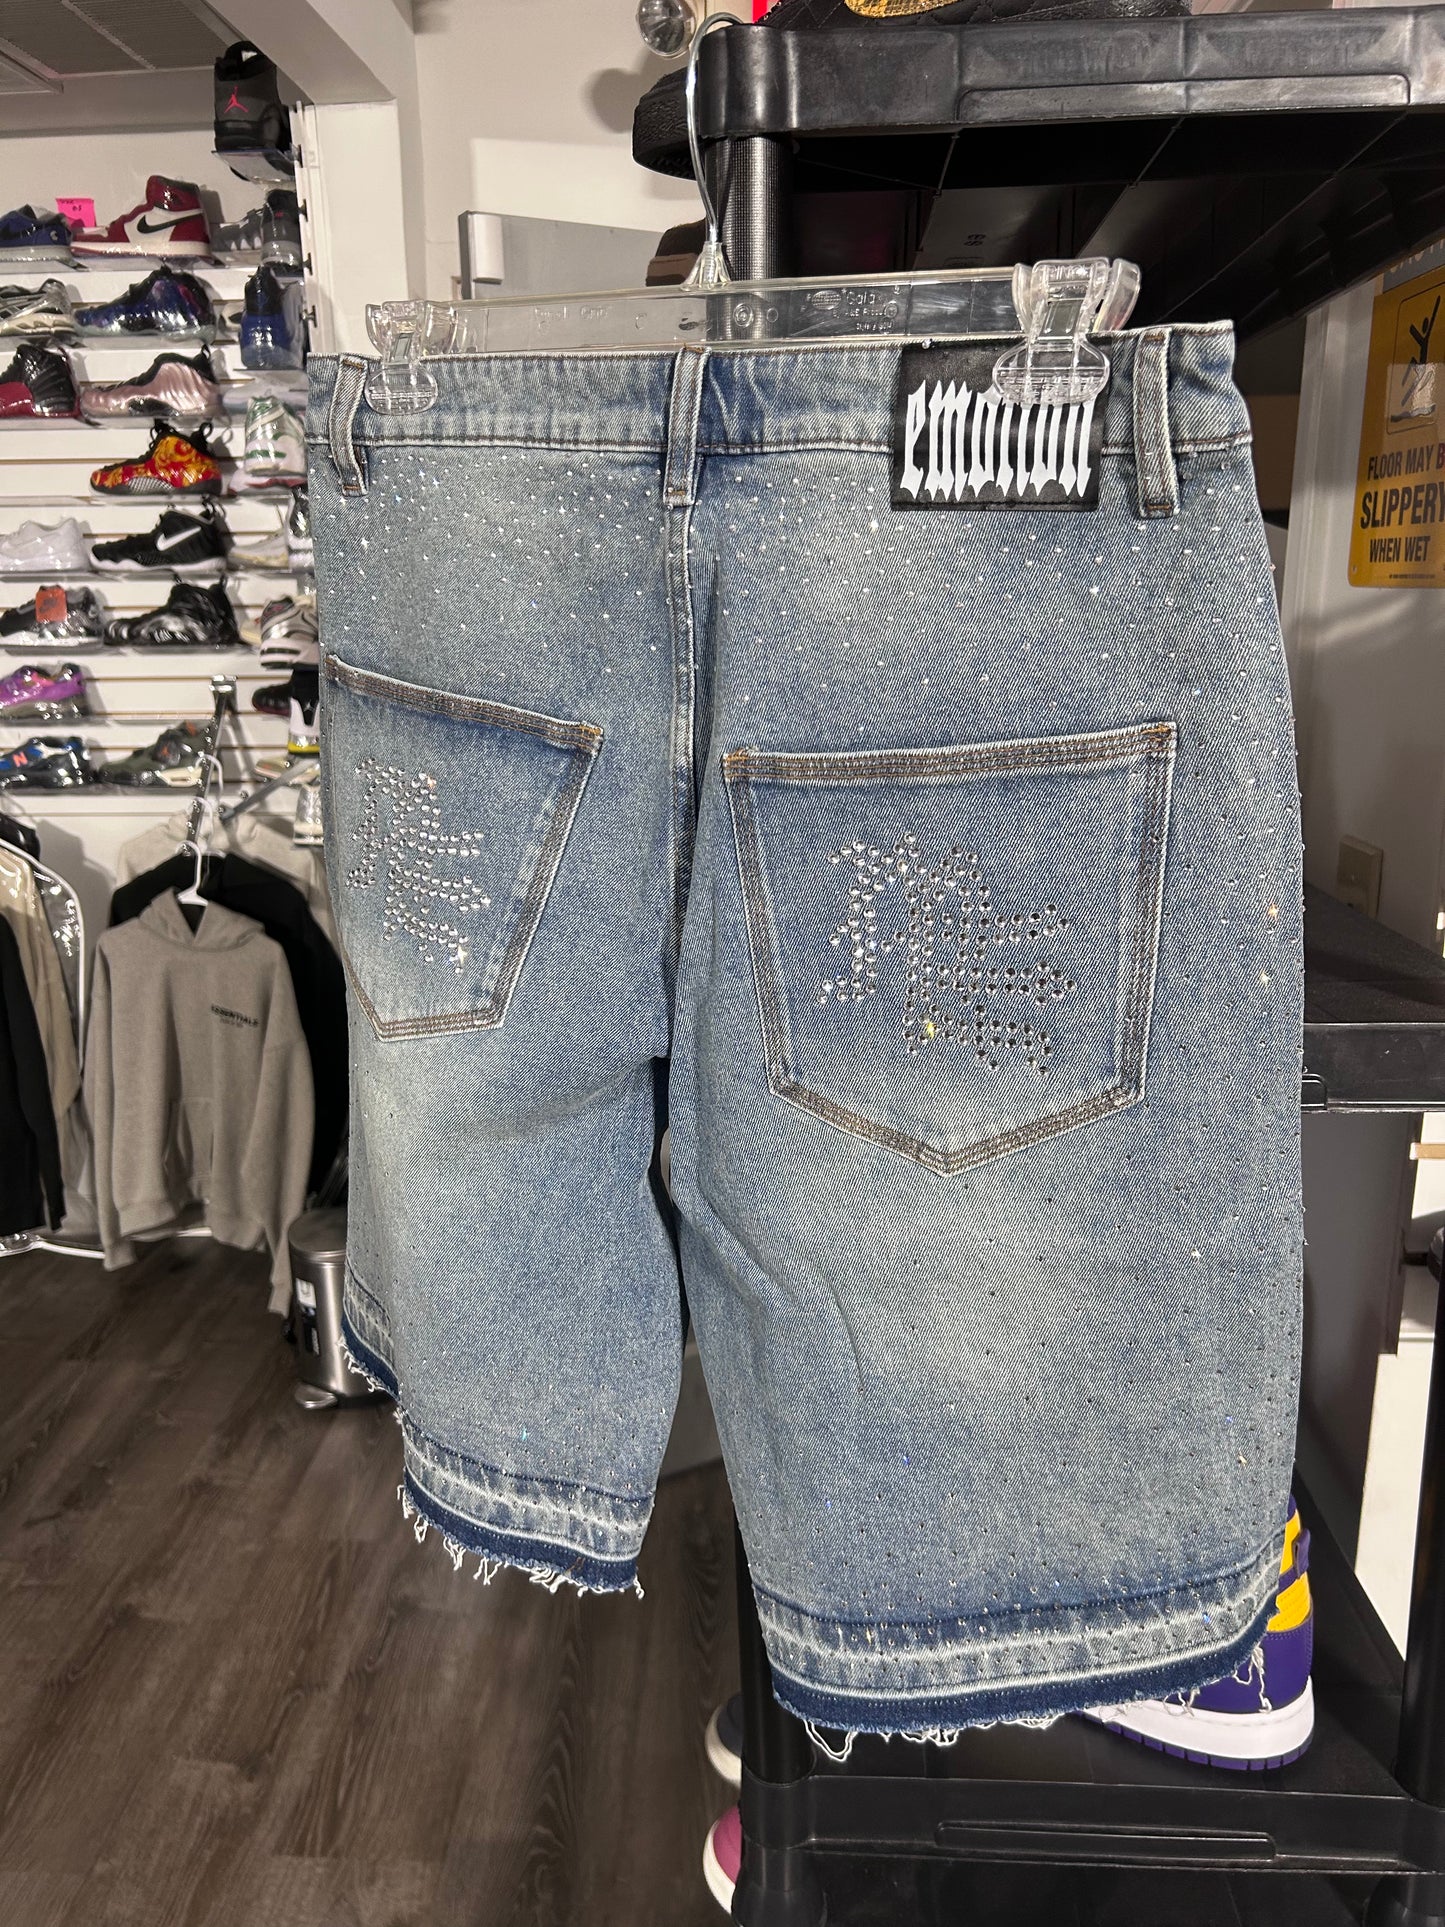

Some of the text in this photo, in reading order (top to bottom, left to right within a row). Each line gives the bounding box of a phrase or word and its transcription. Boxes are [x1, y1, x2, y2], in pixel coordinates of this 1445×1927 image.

[1368, 450, 1403, 481] FLOOR
[1405, 445, 1435, 475] MAY
[1369, 535, 1431, 563] WHEN WET
